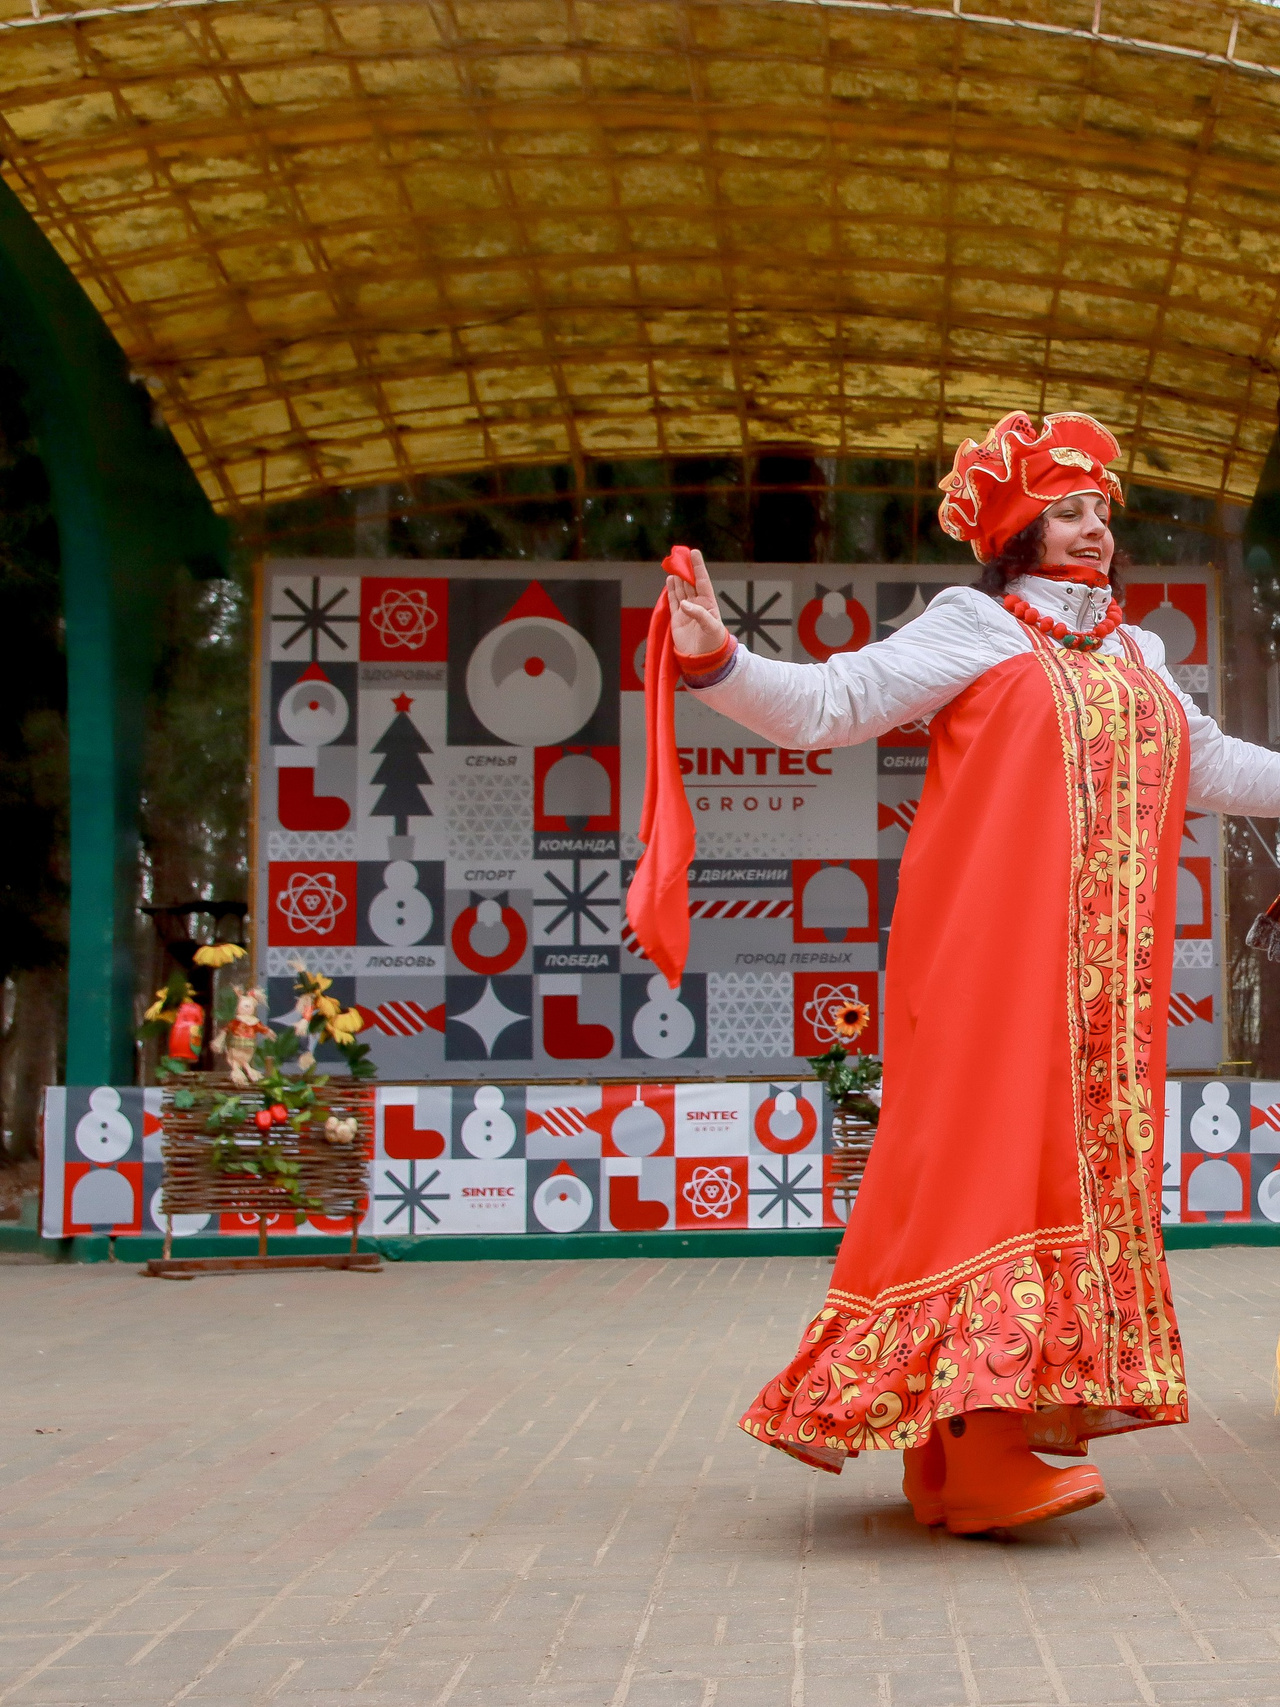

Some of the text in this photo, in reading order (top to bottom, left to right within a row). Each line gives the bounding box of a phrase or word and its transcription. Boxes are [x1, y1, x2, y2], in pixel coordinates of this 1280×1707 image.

[361, 668, 444, 681] ЗДОРОВЬЕ
[465, 755, 517, 767] СЕМЬЯ
[676, 747, 833, 775] SINTEC
[883, 756, 929, 768] ОБНИ
[696, 796, 805, 812] GROUP
[538, 839, 616, 853] КОМАНДА
[464, 869, 516, 881] СПОРТ
[698, 869, 788, 883] ДВИЖЕНИИ
[366, 955, 436, 967] ЛЮБОВЬ
[545, 953, 610, 968] ПОБЕДА
[735, 952, 853, 966] ГОРОД ПЕРВЫХ
[686, 1110, 738, 1121] SINTEC
[461, 1187, 515, 1197] SINTEC
